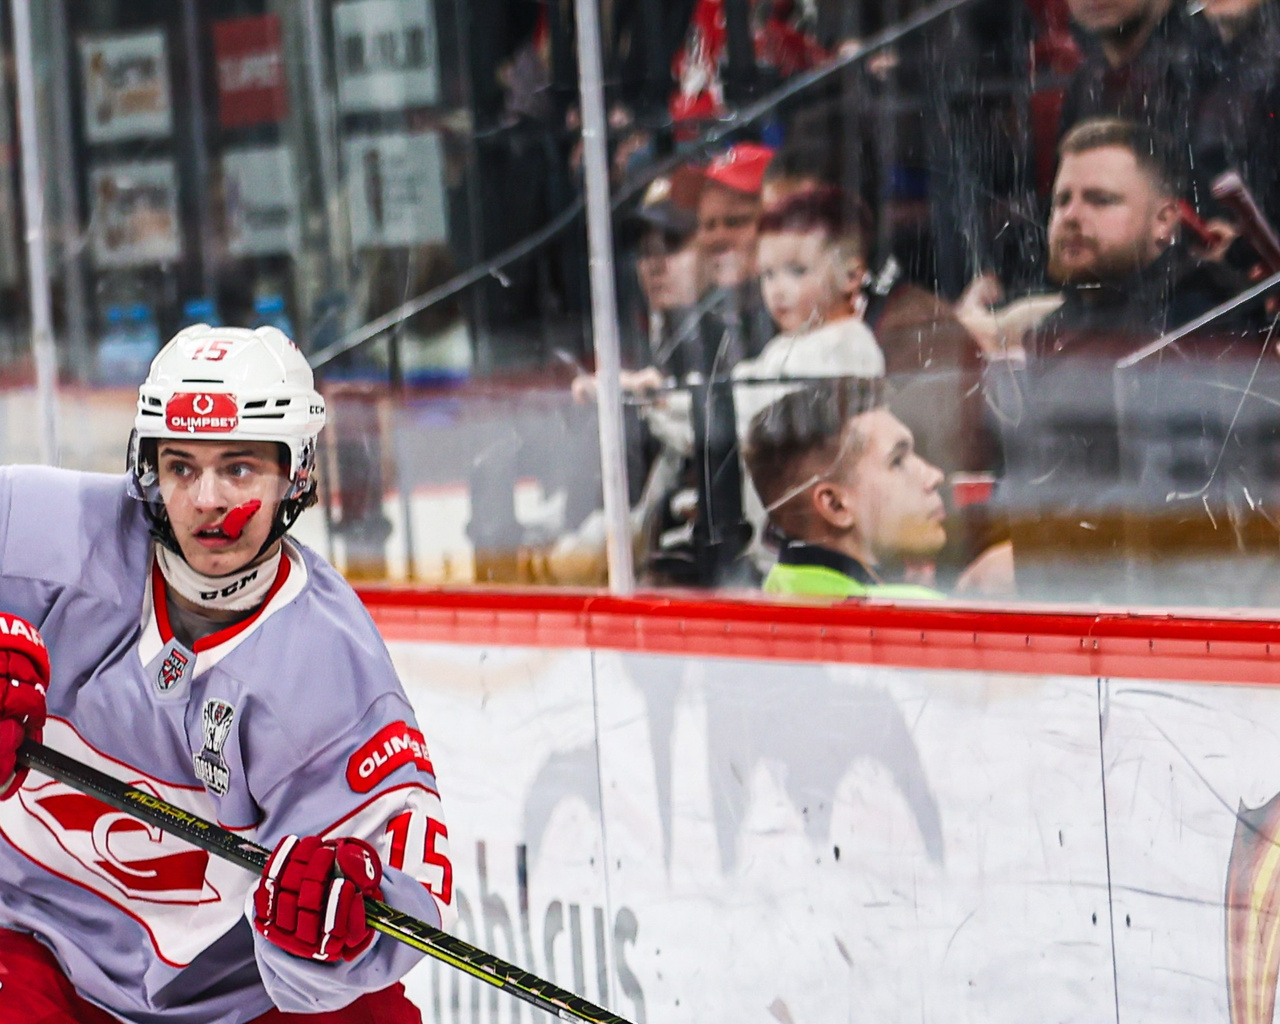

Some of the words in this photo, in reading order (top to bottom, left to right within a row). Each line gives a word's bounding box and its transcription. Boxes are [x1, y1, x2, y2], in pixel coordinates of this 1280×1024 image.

[191, 340, 234, 362] 15
[171, 416, 237, 429] OLIMPBET
[199, 568, 260, 601] CCM
[385, 811, 454, 906] 15
